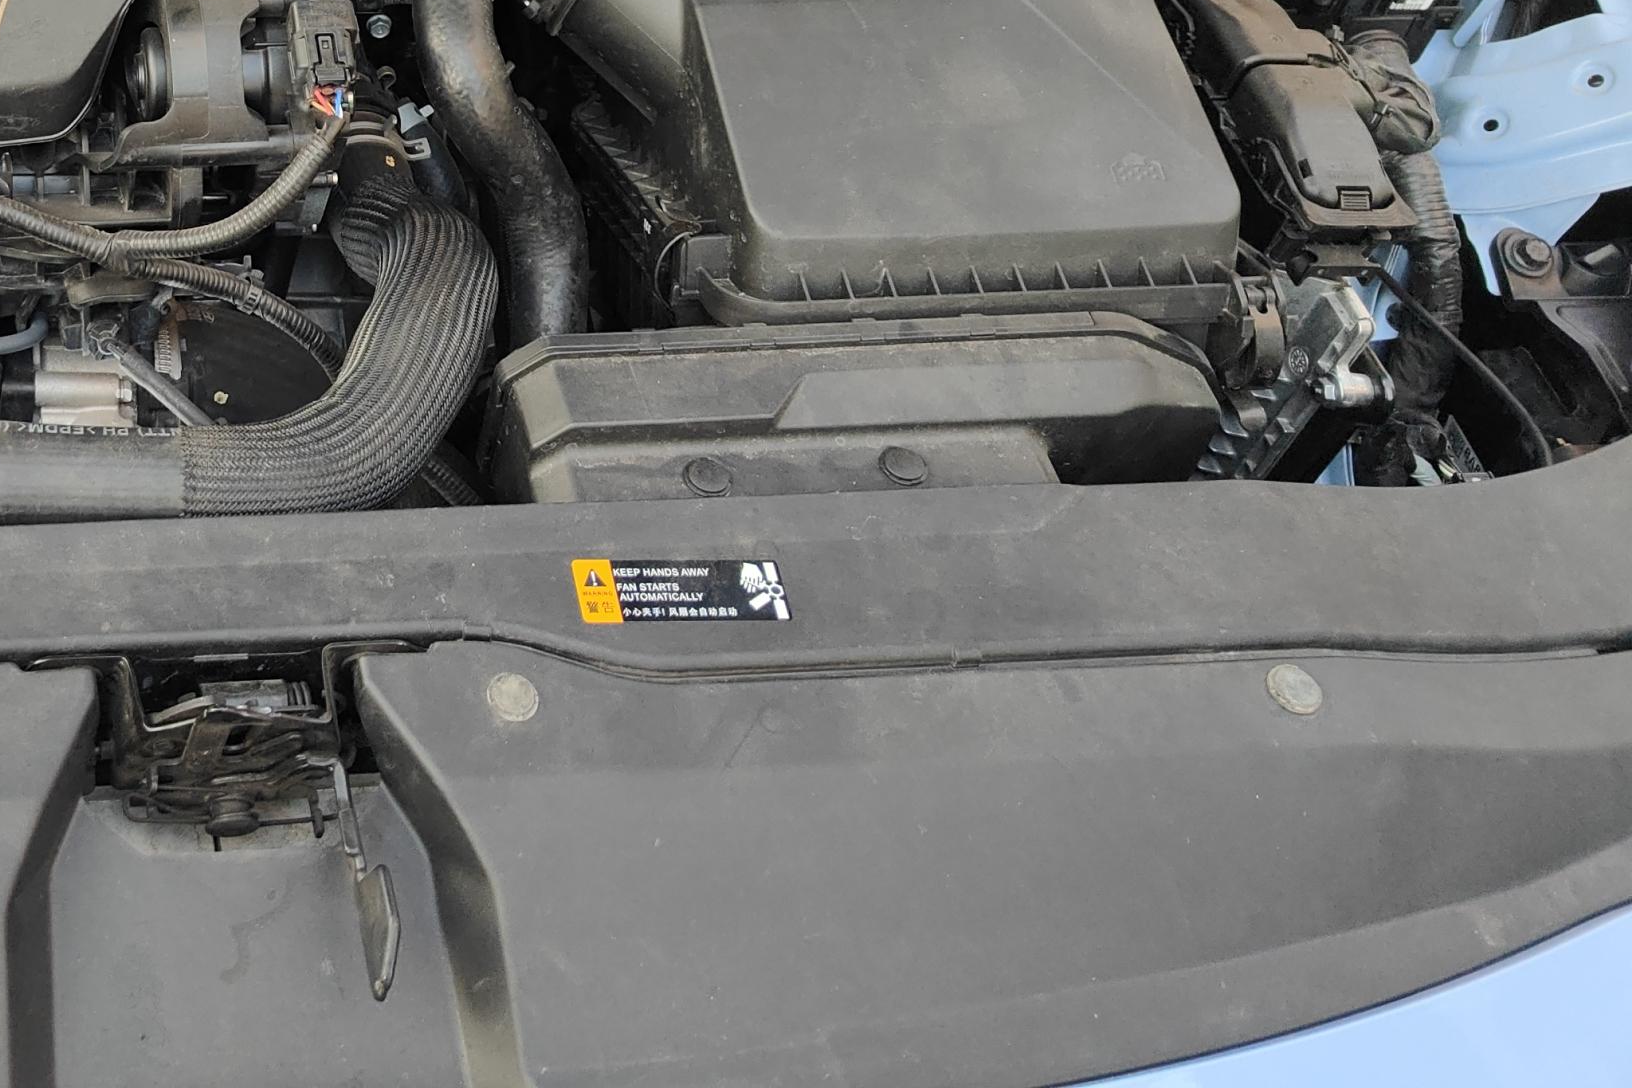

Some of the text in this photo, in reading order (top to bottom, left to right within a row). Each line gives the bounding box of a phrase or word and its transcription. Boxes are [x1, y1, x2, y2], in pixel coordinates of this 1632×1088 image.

[613, 568, 709, 576] KEEP HANDS AWAY
[616, 583, 680, 591] FAN STARTS
[620, 593, 704, 602] AUTOMATICALLY
